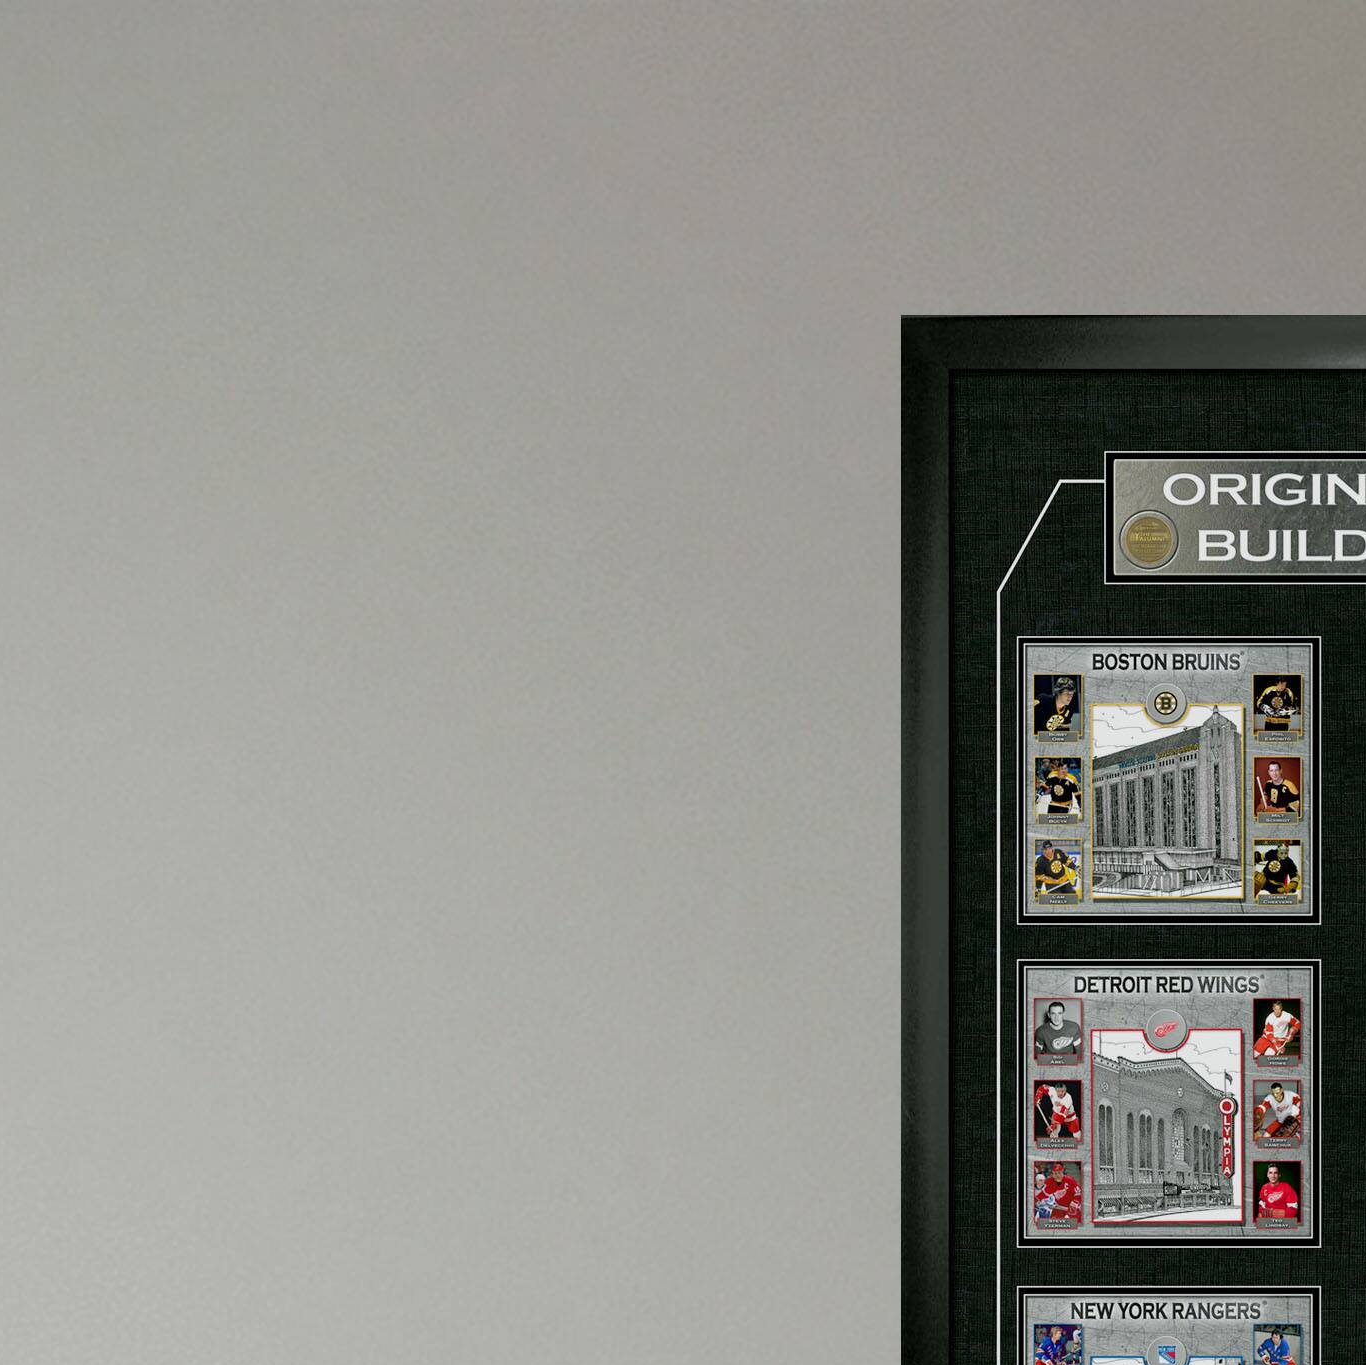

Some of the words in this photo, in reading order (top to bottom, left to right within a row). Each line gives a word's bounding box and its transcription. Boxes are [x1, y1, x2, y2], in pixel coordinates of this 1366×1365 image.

[1092, 653, 1166, 671] BOSTON
[1172, 653, 1240, 671] BRUINS
[1074, 976, 1152, 993] DETROIT
[1156, 976, 1194, 993] RED
[1197, 976, 1259, 993] WINGS
[1219, 1098, 1235, 1175] OLYMPIA
[1071, 1302, 1114, 1320] NEW
[1117, 1302, 1168, 1320] YORK
[1172, 1302, 1261, 1320] RANGERS
